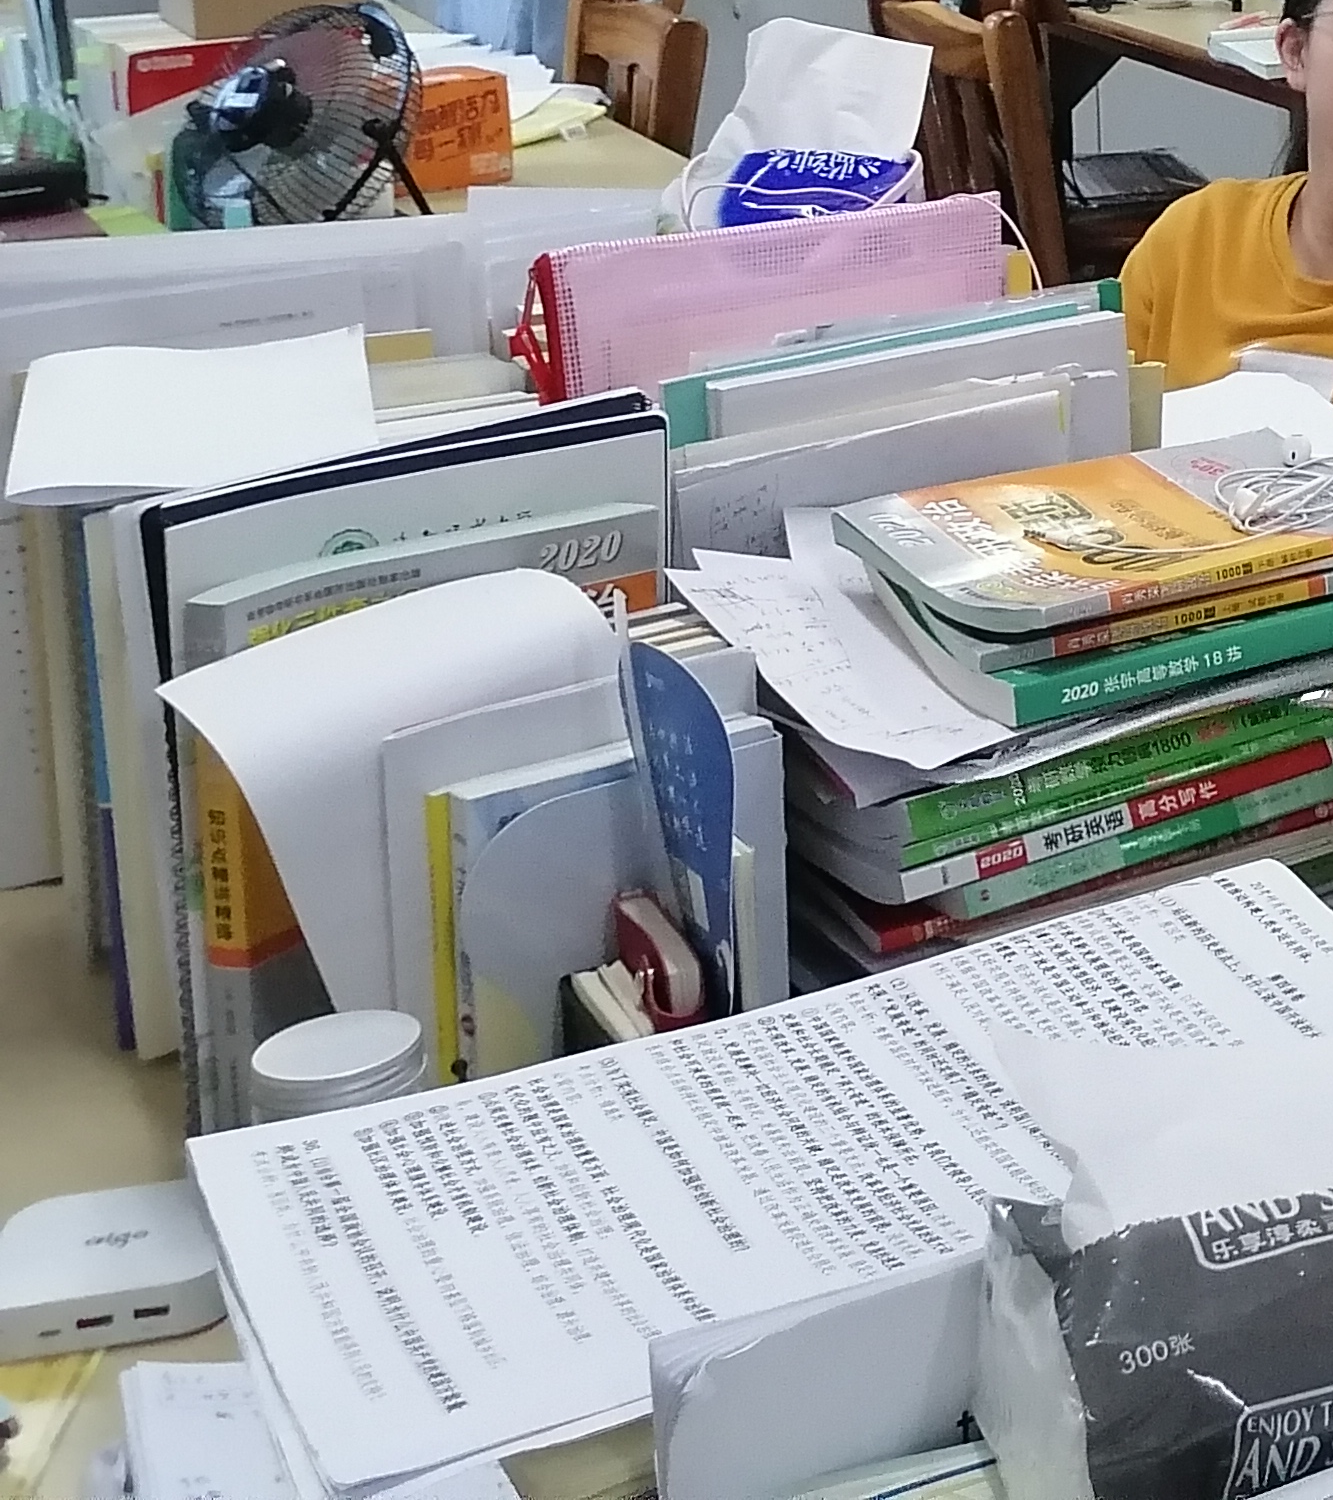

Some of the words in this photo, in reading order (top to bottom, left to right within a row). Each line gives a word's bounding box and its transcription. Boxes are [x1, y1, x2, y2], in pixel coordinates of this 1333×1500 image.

[534, 530, 625, 573] 2020
[1058, 680, 1100, 705] 2020
[1101, 653, 1201, 693] 张宇高等数学
[1202, 650, 1224, 669] 18
[977, 843, 1025, 870] 2020
[1038, 806, 1131, 853] 考研英语
[1135, 779, 1221, 821] 高分写作
[1118, 1331, 1195, 1375] 300张
[1246, 1403, 1315, 1442] ENJOY
[1235, 1436, 1322, 1489] AND
